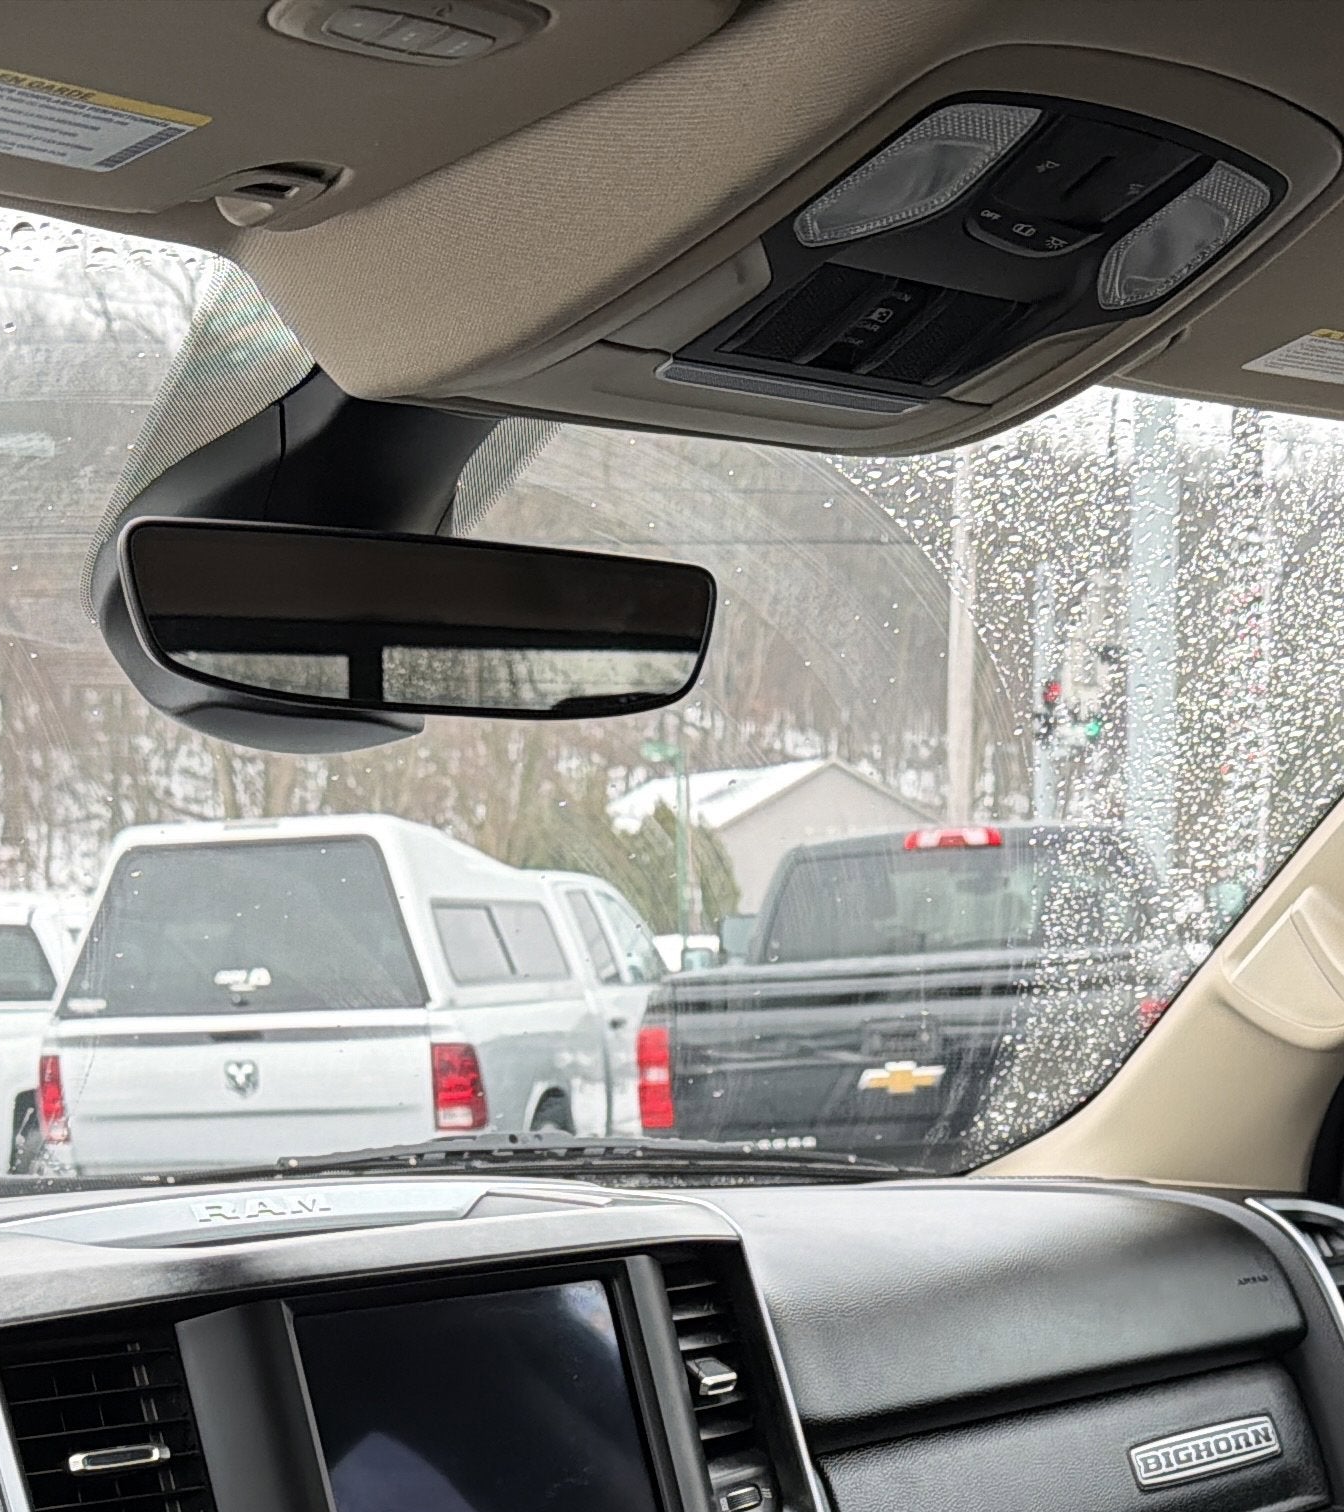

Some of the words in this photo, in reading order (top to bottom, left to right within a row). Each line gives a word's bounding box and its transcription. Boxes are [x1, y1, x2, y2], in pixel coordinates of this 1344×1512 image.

[980, 209, 1002, 221] OFF
[192, 1193, 332, 1222] RAM
[1138, 1425, 1274, 1476] BIGHORN
